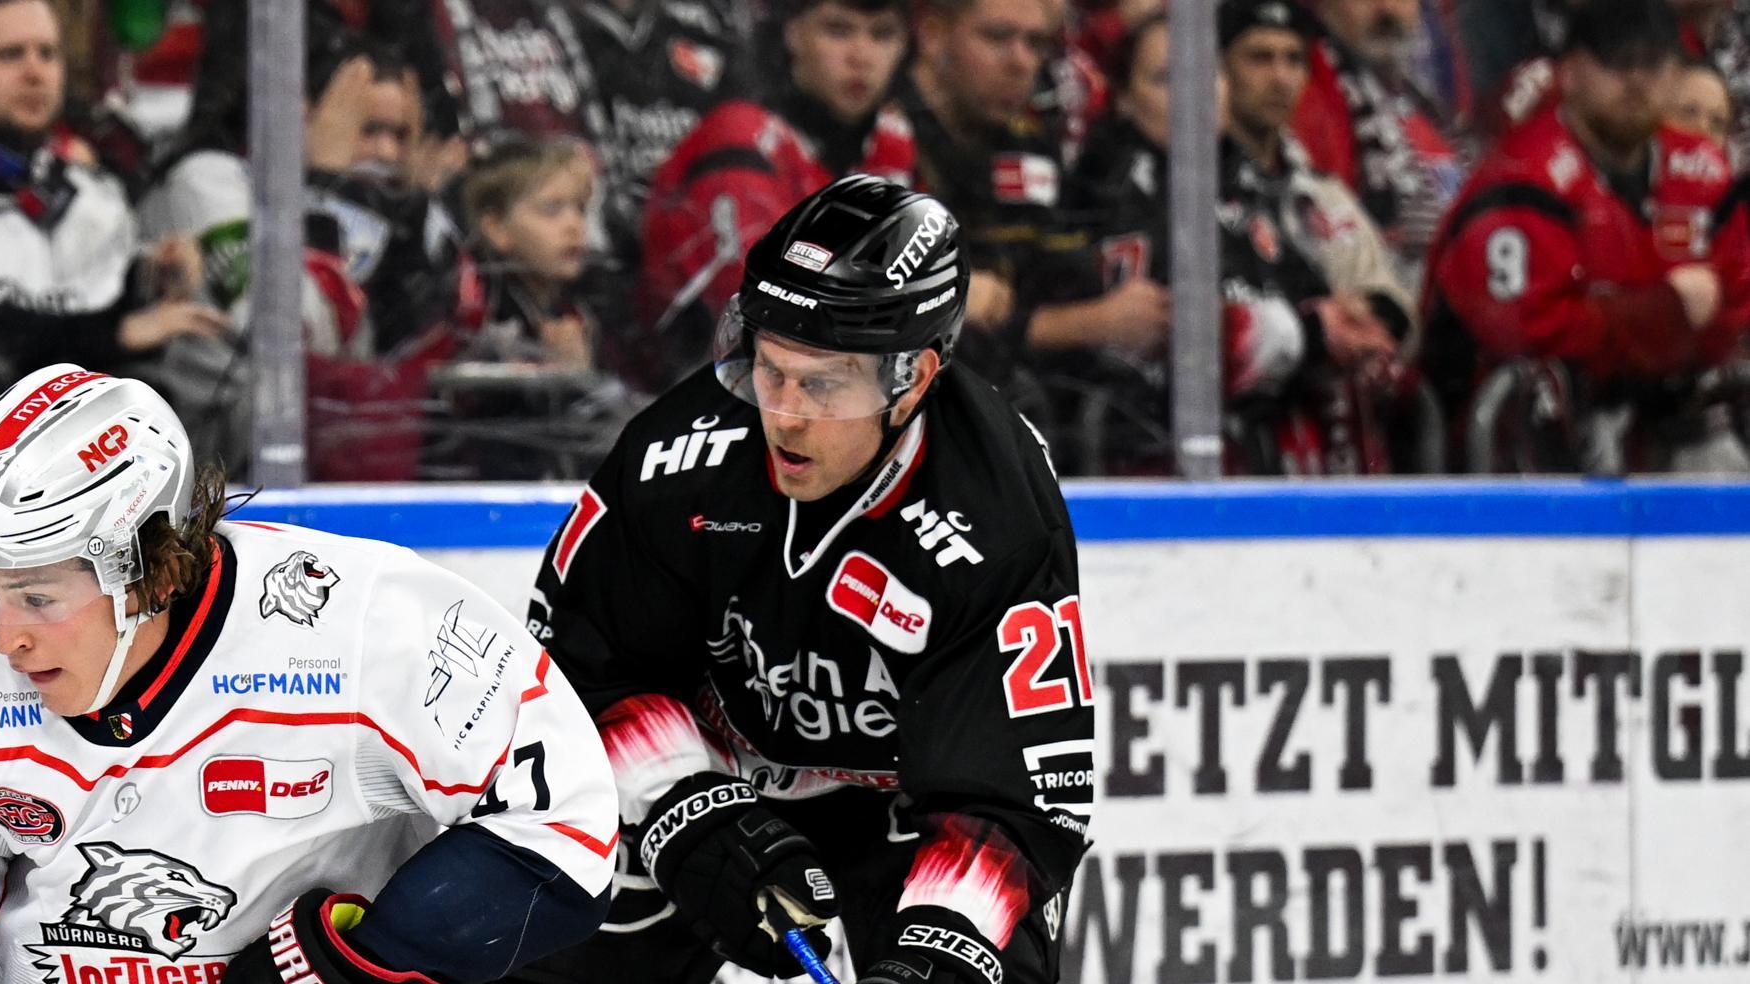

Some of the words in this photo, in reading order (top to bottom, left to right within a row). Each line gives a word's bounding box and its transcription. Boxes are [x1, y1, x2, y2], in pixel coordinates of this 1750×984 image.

[886, 206, 948, 291] STETSON
[756, 280, 818, 310] BAUER
[13, 391, 52, 422] my
[288, 656, 341, 669] Personal
[996, 594, 1095, 719] 21
[1095, 655, 1391, 798] ETZT
[1030, 770, 1094, 790] TRICOR
[641, 782, 758, 868] ERWOOD
[46, 924, 144, 950] NÜRNBERG
